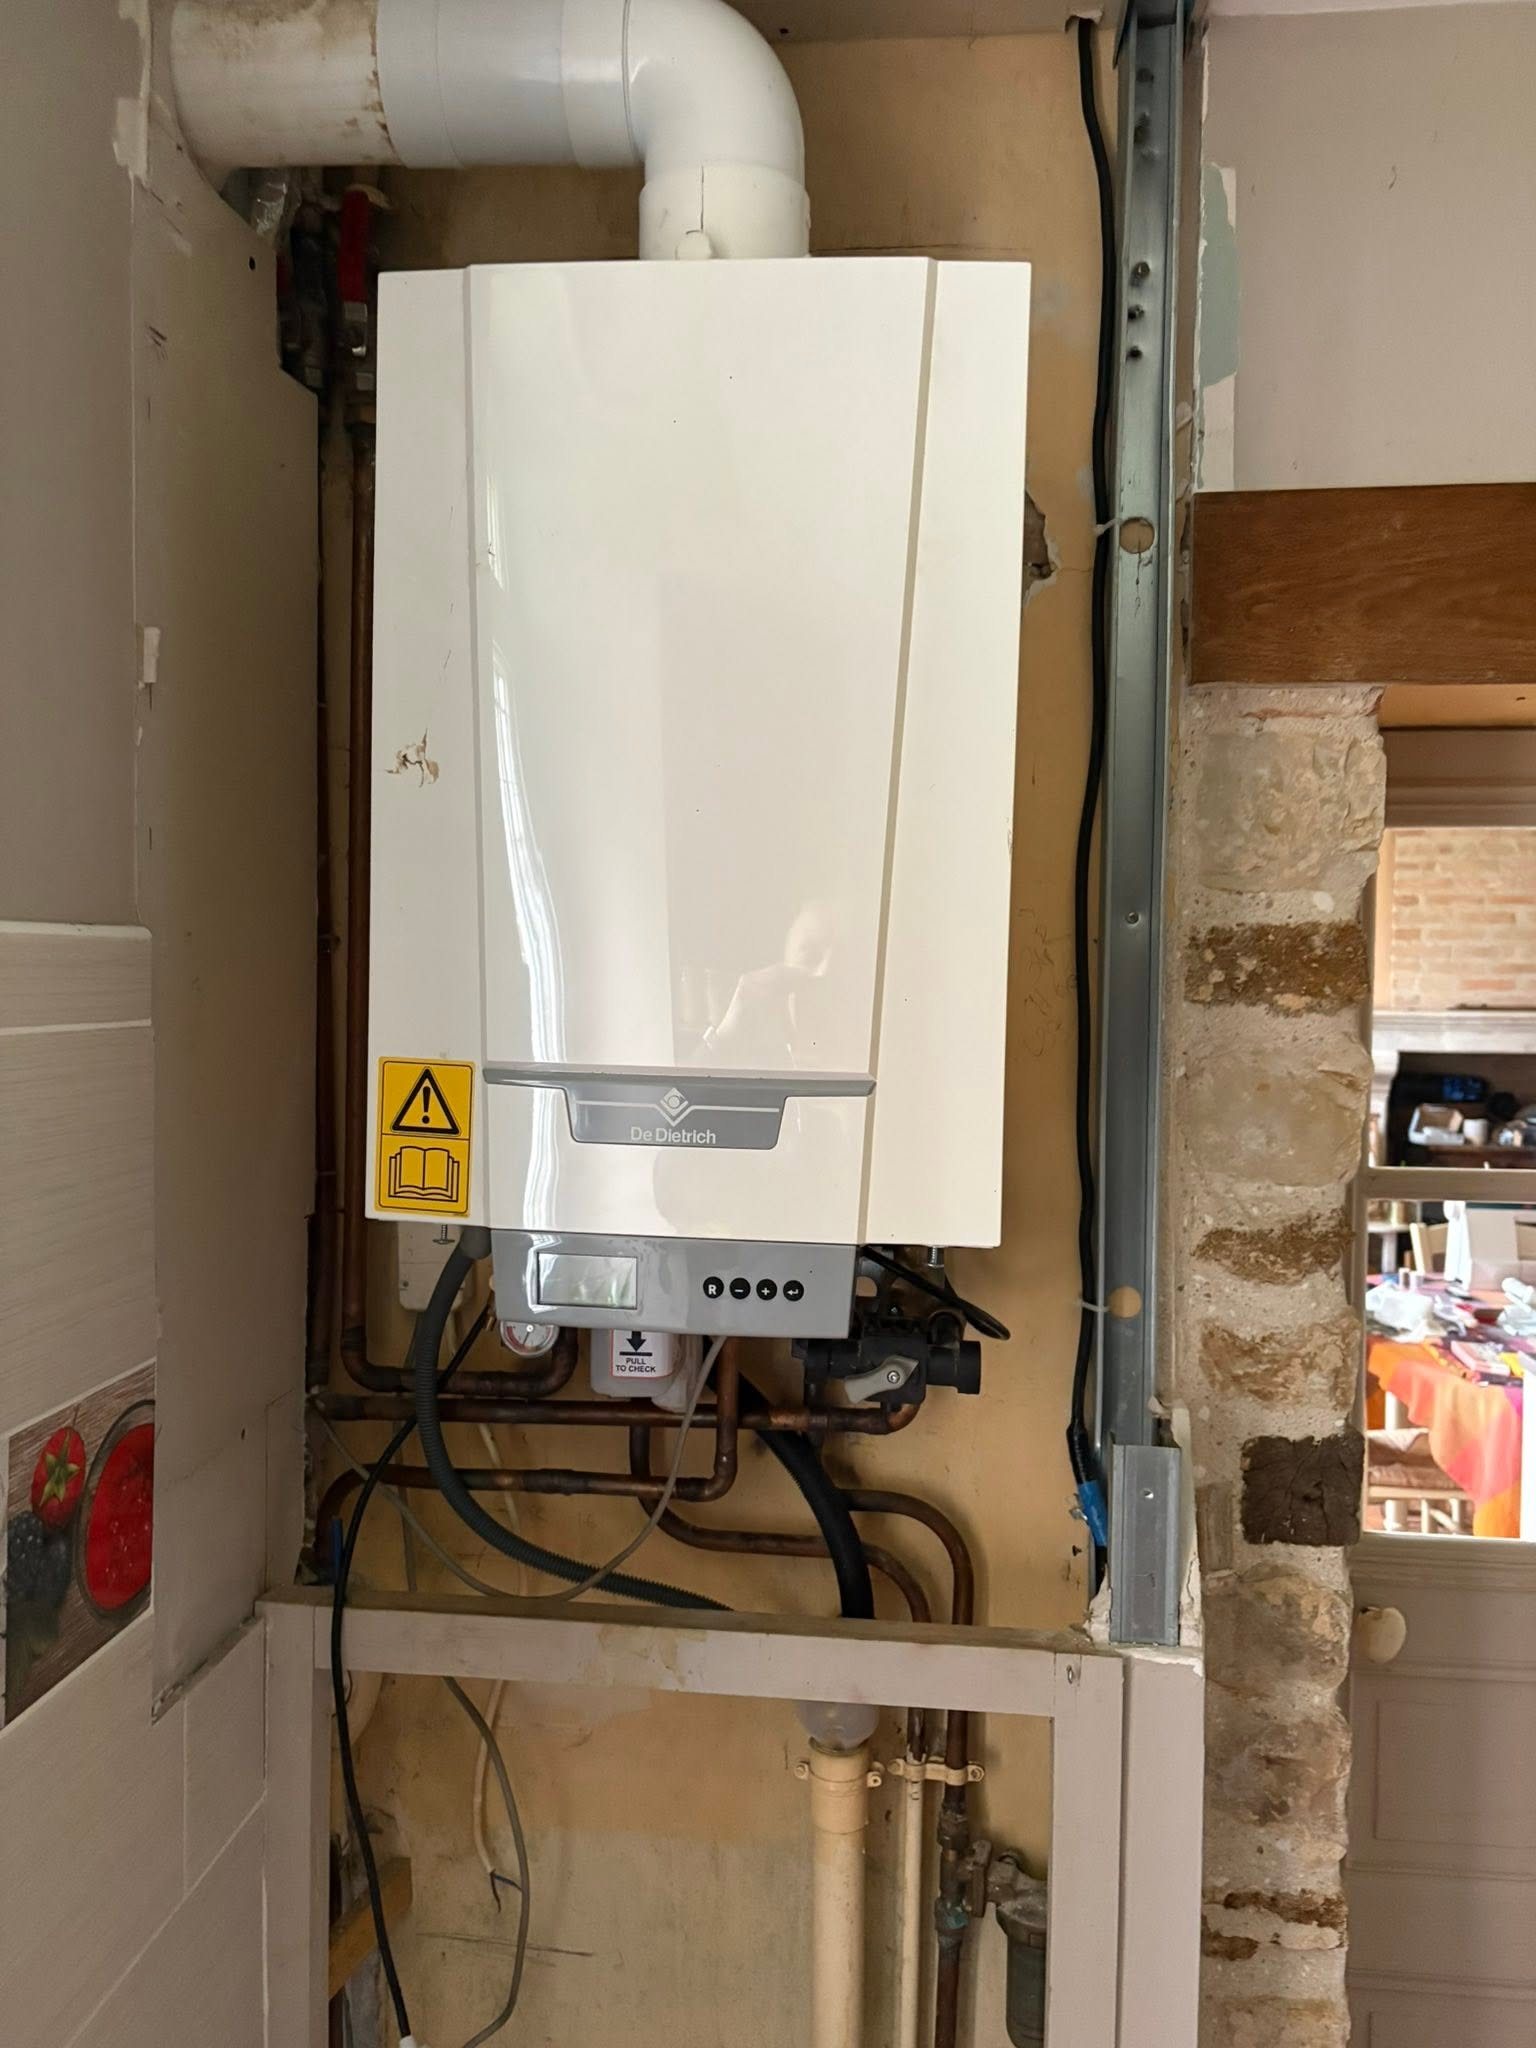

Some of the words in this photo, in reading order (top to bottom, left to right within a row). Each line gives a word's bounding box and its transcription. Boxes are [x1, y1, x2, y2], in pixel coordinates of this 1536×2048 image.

[630, 1126, 653, 1141] De
[655, 1127, 716, 1144] Dietrich
[708, 1284, 717, 1295] R
[625, 1357, 647, 1365] PULL
[628, 1365, 656, 1373] CHECK
